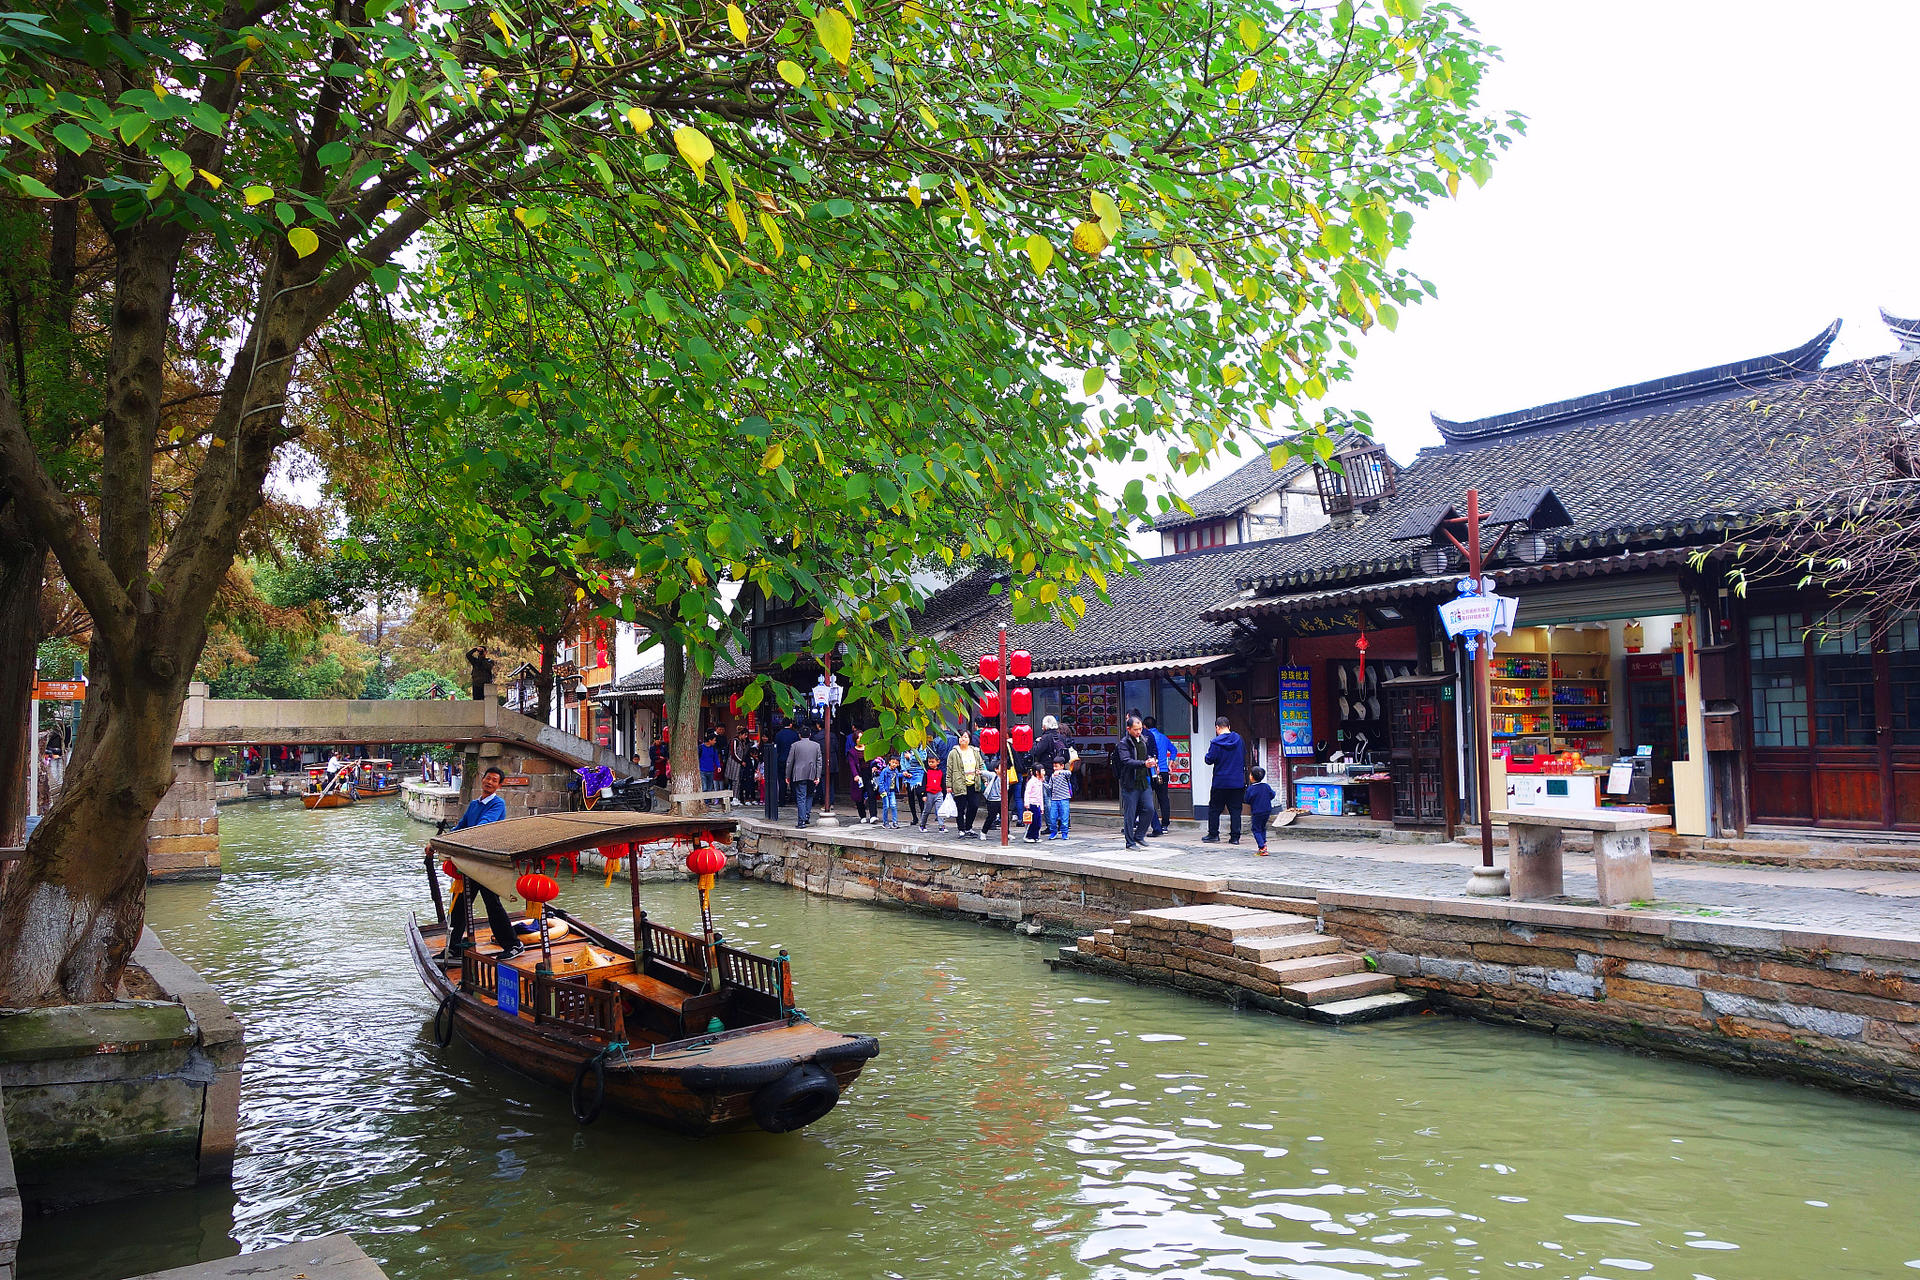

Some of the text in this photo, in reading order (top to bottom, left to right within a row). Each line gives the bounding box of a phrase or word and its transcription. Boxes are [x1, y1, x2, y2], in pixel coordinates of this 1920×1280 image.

[1281, 671, 1309, 681] 珍珠批发
[1282, 710, 1309, 720] 免费加工
